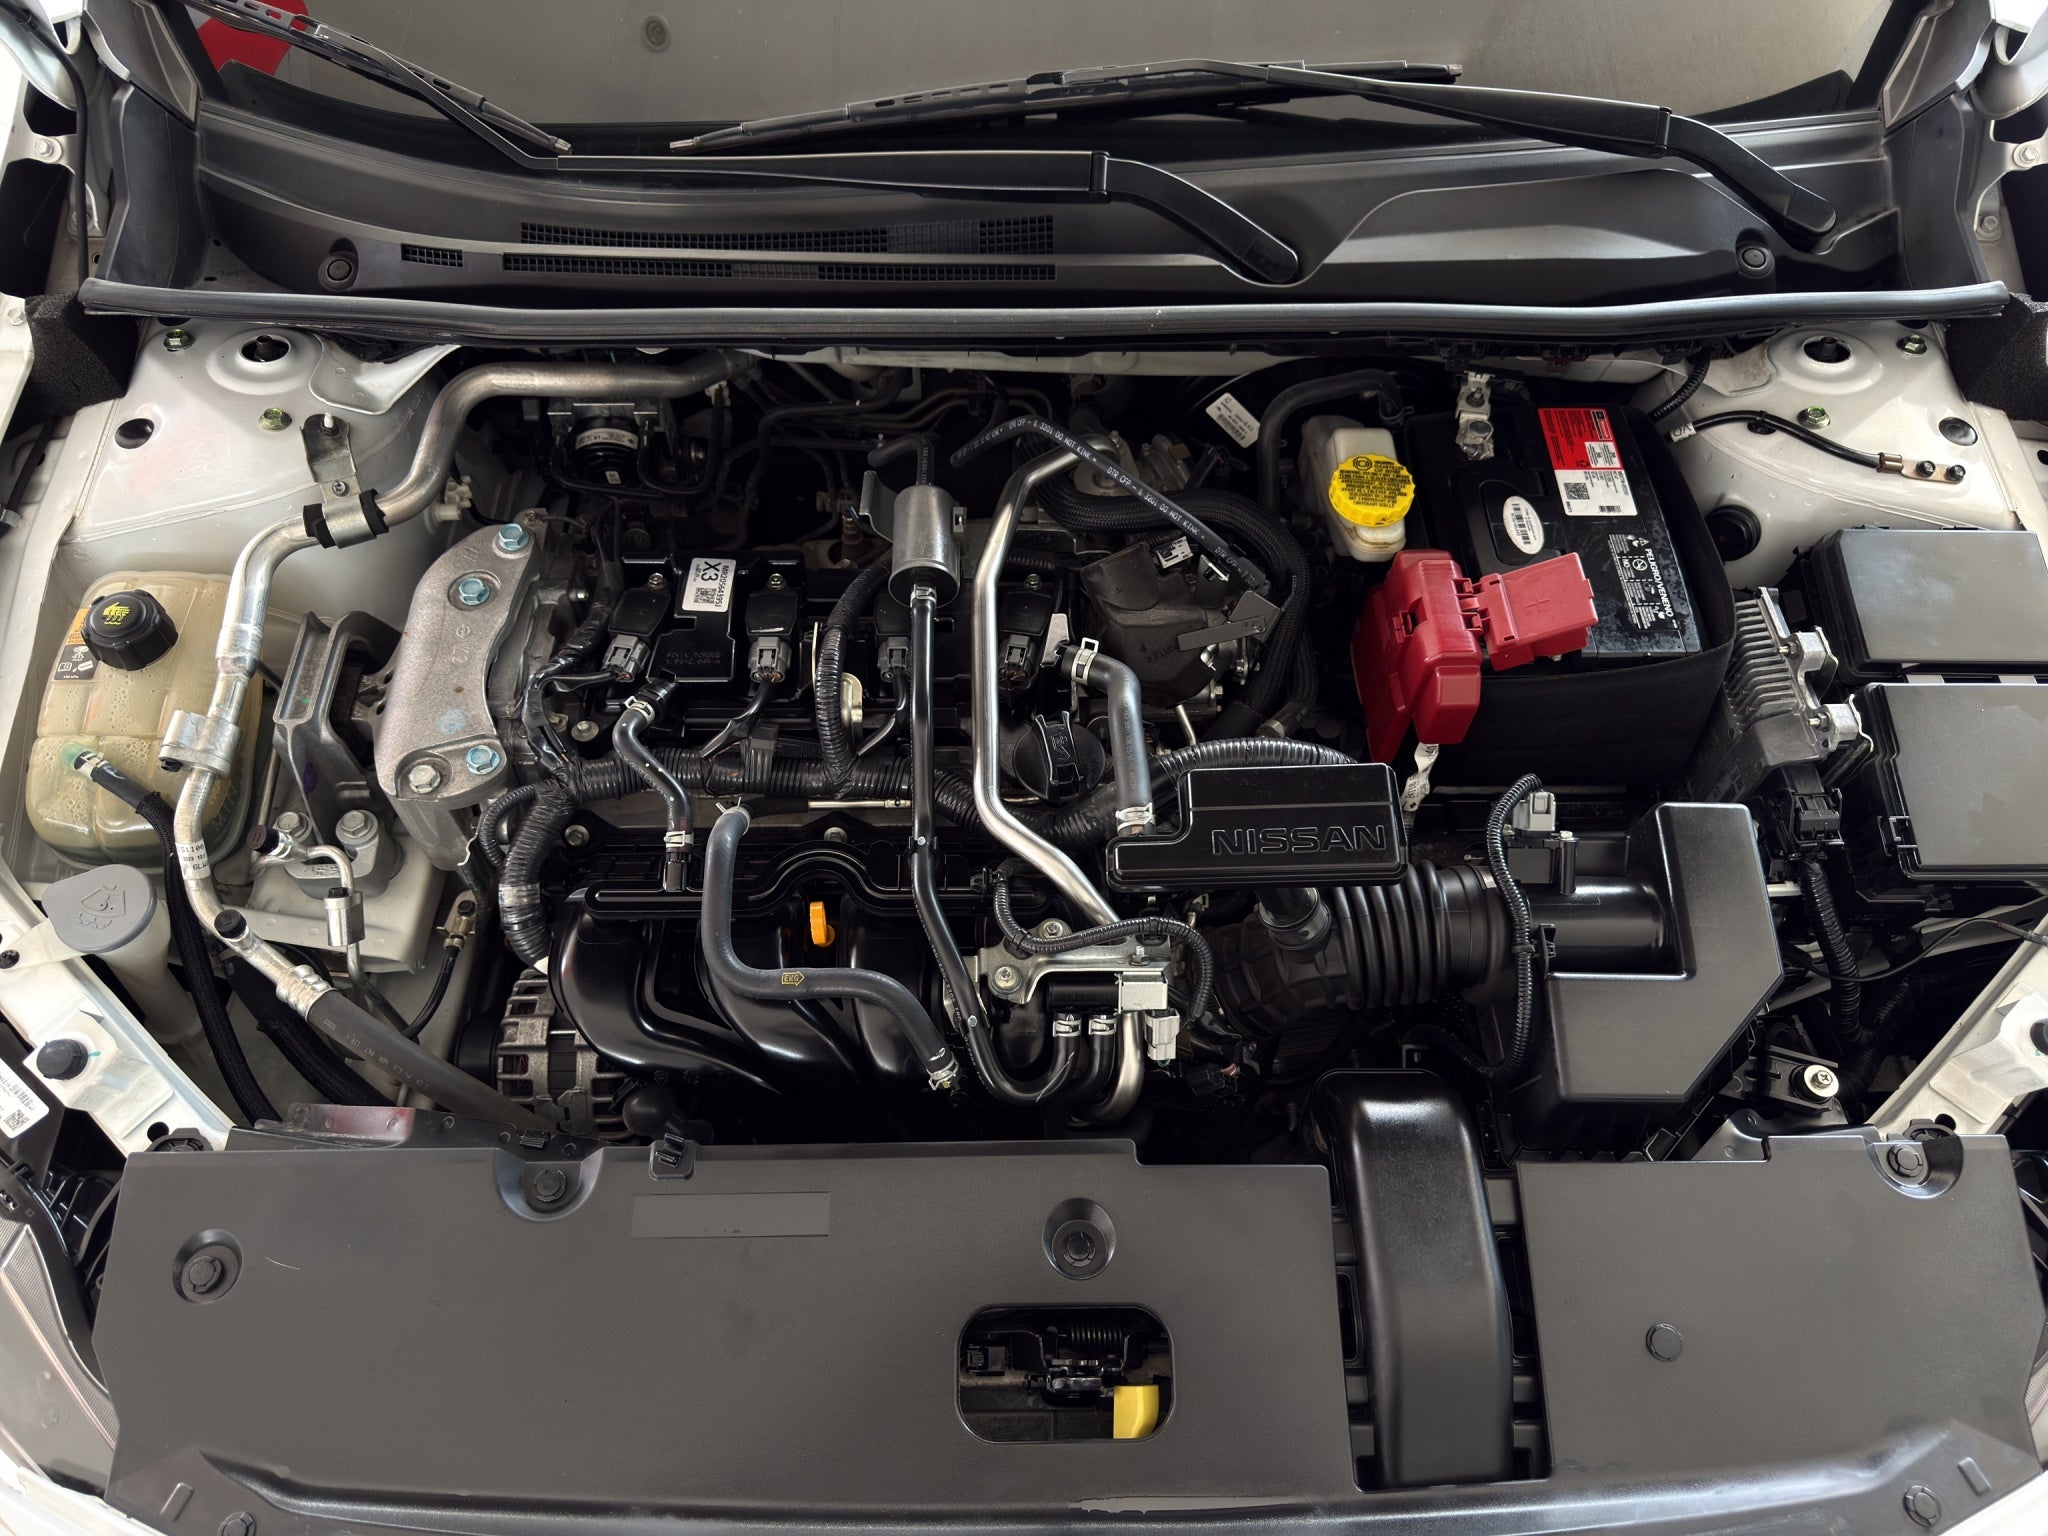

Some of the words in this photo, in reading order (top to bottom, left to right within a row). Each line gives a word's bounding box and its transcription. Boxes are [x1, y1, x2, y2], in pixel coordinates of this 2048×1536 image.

[1064, 437, 1077, 449] NOT
[1076, 445, 1092, 460] KINK
[1169, 508, 1183, 522] NOT
[1183, 520, 1200, 536] KINK
[701, 561, 721, 581] X3
[1622, 558, 1631, 568] NO
[1645, 548, 1674, 617] PELIGRO/VENENO
[1211, 825, 1386, 856] NISSAN
